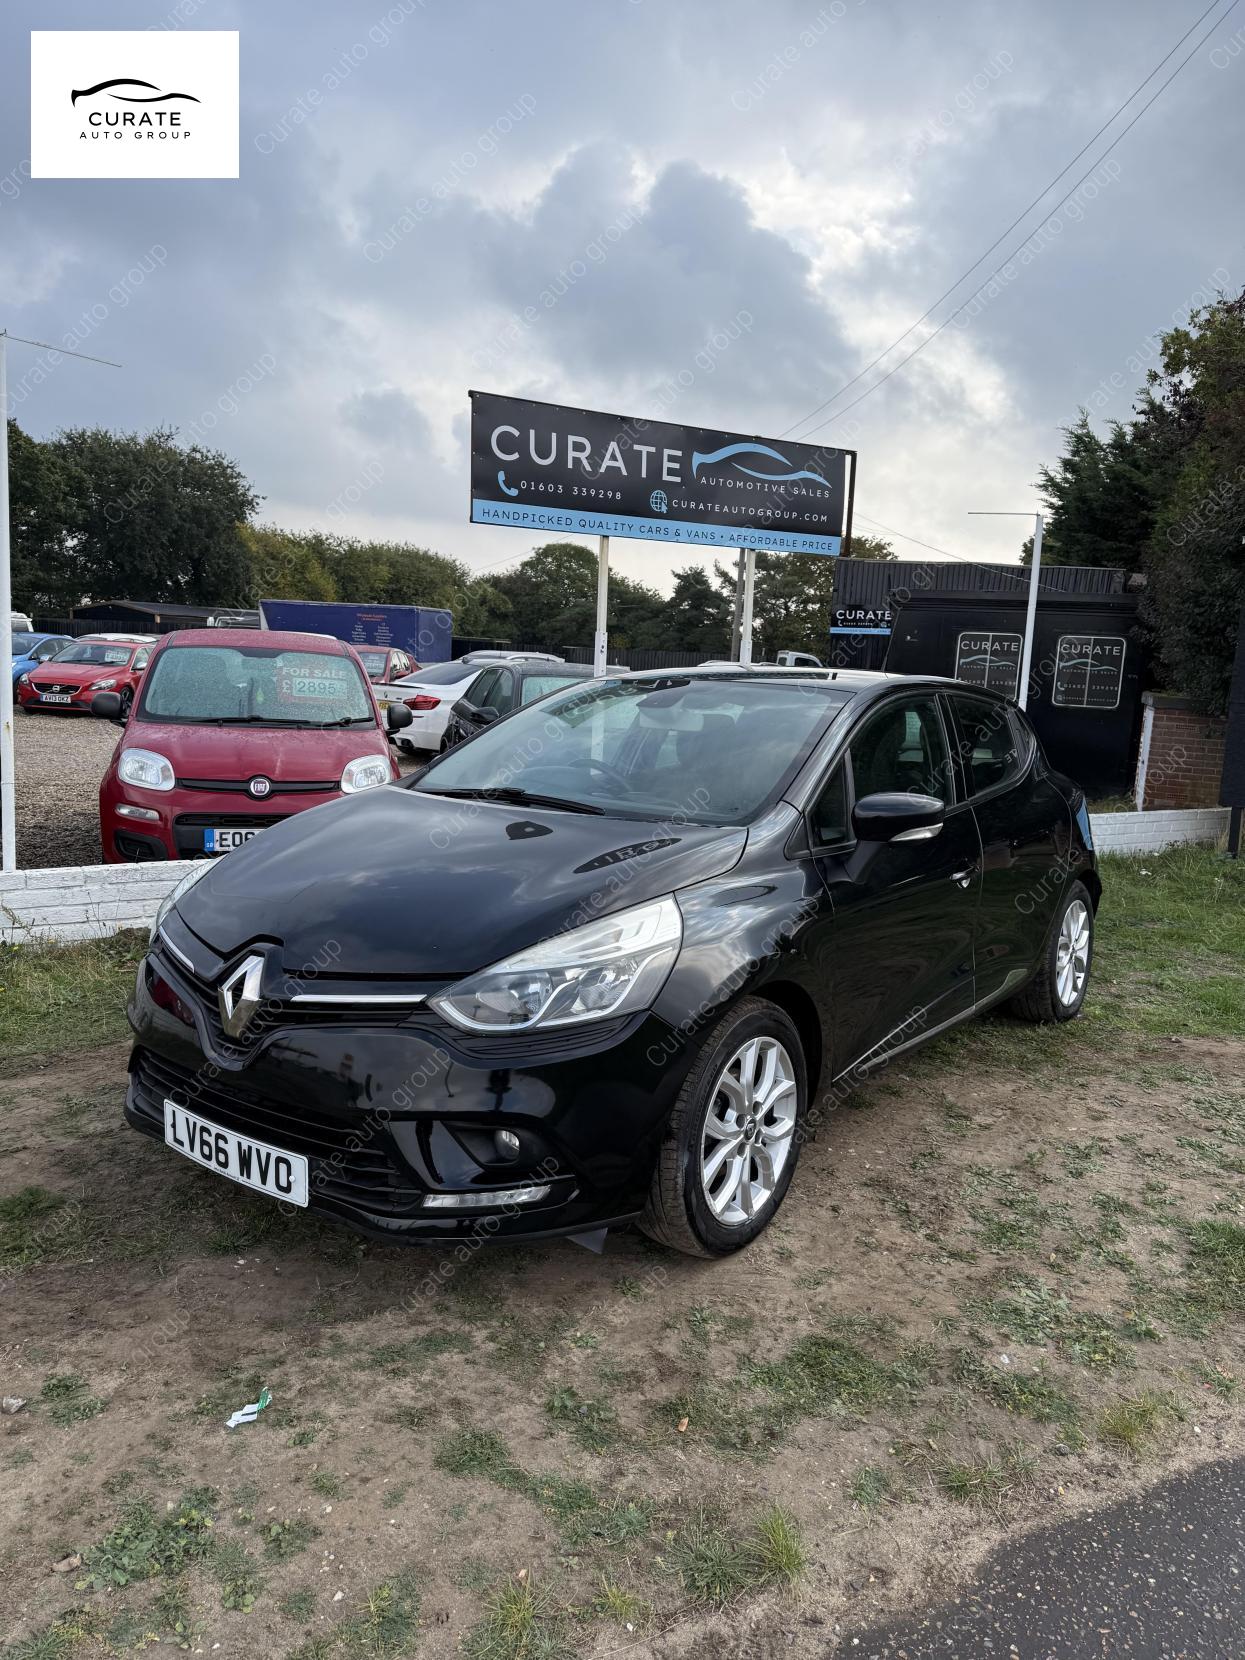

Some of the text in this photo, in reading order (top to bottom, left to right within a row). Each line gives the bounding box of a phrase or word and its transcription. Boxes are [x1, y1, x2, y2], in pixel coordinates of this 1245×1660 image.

[491, 425, 683, 483] CURATE
[520, 480, 622, 500] 01603 339298
[700, 476, 831, 498] AUTOMOTIVE SALES
[672, 499, 828, 522] CURATEAUTOGROUP.COM
[482, 508, 833, 551] HANDPICKED QUALITY CARS & VANS AFFORDABLE PRICE
[836, 610, 892, 620] CURATE
[961, 641, 1019, 651] CURATE
[1061, 644, 1120, 655] CURATE
[282, 667, 346, 679] FOR SALE
[255, 783, 266, 792] FIAT
[171, 1109, 292, 1194] LV66 WVO
